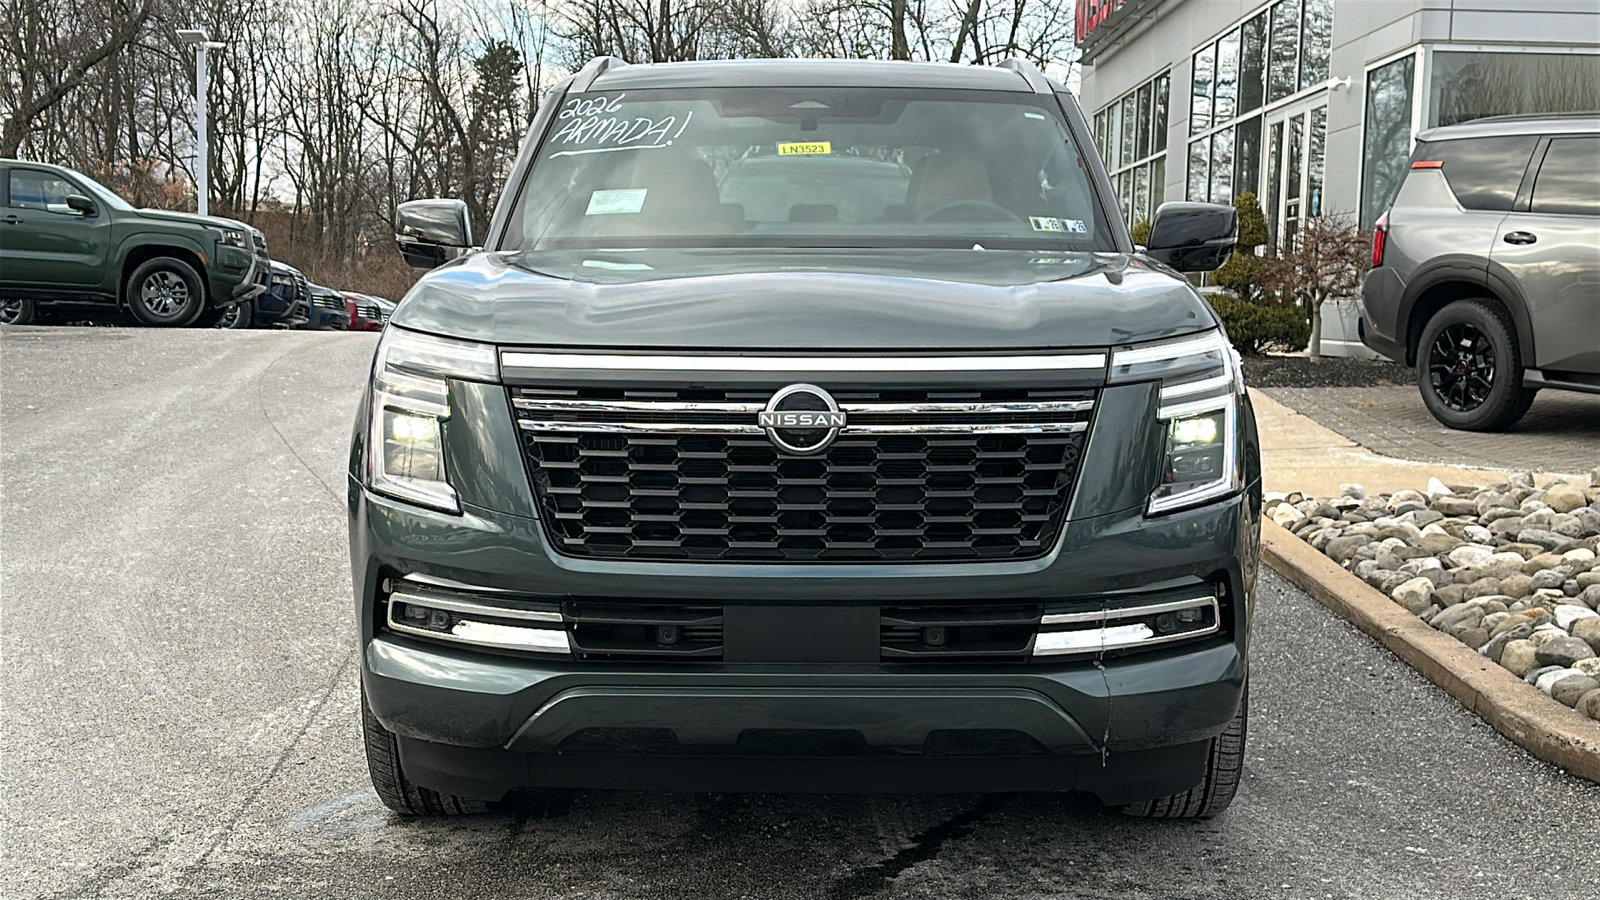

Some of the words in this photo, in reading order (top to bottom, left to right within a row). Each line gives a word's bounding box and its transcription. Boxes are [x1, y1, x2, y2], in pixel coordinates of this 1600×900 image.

[559, 93, 625, 119] 2026
[550, 111, 693, 146] ARMADA!
[782, 144, 825, 154] LN3523
[760, 414, 845, 426] NISSAN
